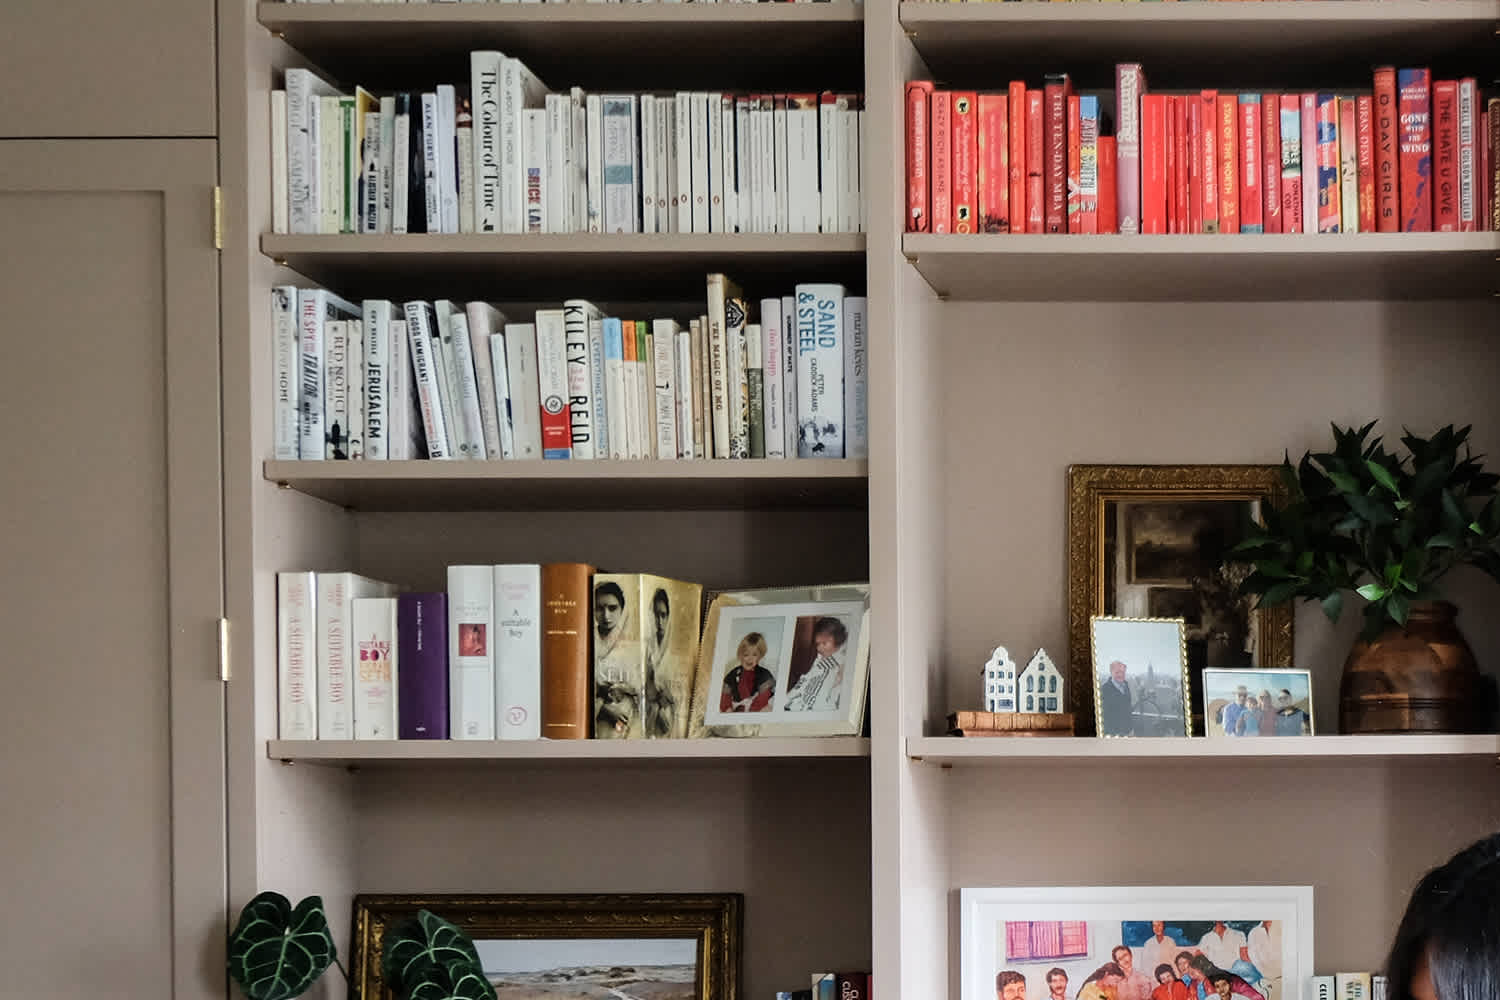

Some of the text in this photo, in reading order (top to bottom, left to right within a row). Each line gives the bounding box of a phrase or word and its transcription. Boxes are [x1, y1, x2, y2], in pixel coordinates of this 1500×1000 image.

[424, 103, 435, 161] ALAN FURST
[937, 95, 945, 127] CRAZY
[1359, 99, 1370, 166] KIRAN DESAI
[1401, 113, 1429, 123] GONE
[1405, 124, 1423, 132] WITH
[480, 70, 499, 211] The Colour of Time
[937, 131, 945, 154] RICH
[1053, 94, 1063, 211] THE TEN-DAY MBA
[1222, 103, 1233, 194] STAR OF THE NORTH
[1379, 93, 1393, 218] D-DAY GIRLS
[1401, 144, 1430, 152] WIND
[1439, 98, 1452, 216] THE HATE U GIVE
[527, 167, 541, 204] BRICK
[937, 158, 945, 193] ASIANS
[1462, 149, 1472, 180] COLSON
[303, 298, 316, 341] THE SPY
[711, 321, 720, 341] THE
[798, 292, 816, 357] & STEEL
[817, 300, 836, 348] SAND
[303, 352, 319, 398] TRAITOR
[333, 336, 345, 416] RED NOTICE
[413, 338, 429, 383] IMMIGRANT
[564, 304, 590, 444] KILEY REID
[712, 344, 721, 376] MAGIC
[367, 361, 381, 439] JERUSALEM
[714, 379, 722, 391] OF
[817, 374, 825, 395] PETER
[359, 649, 390, 661] BOY
